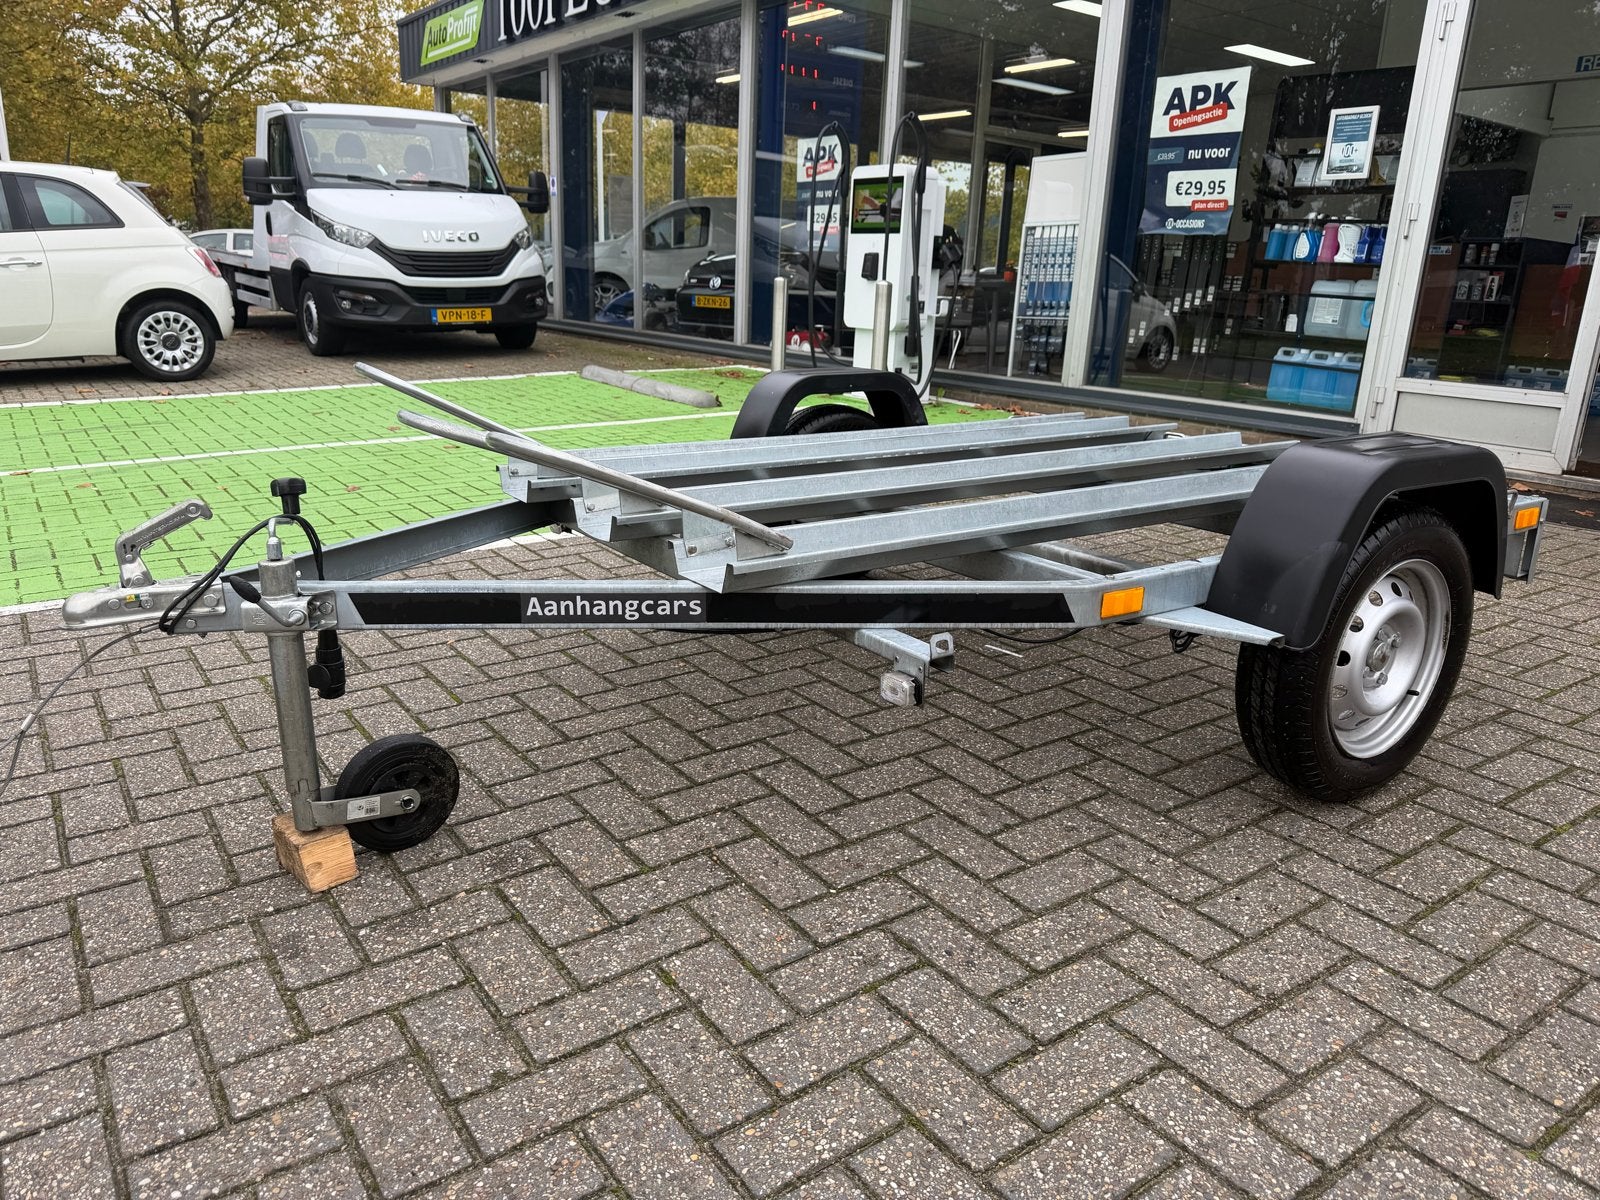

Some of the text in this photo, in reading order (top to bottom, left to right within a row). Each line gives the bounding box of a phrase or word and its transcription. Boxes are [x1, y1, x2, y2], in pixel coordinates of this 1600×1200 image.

[1162, 81, 1239, 116] APK
[1173, 107, 1223, 127] Openingsactie
[1188, 147, 1231, 160] nu voor
[1175, 180, 1226, 197] €29,95
[422, 230, 480, 243] IVECO
[440, 309, 487, 321] VPN-18-F
[526, 595, 702, 621] Aanhangcars
